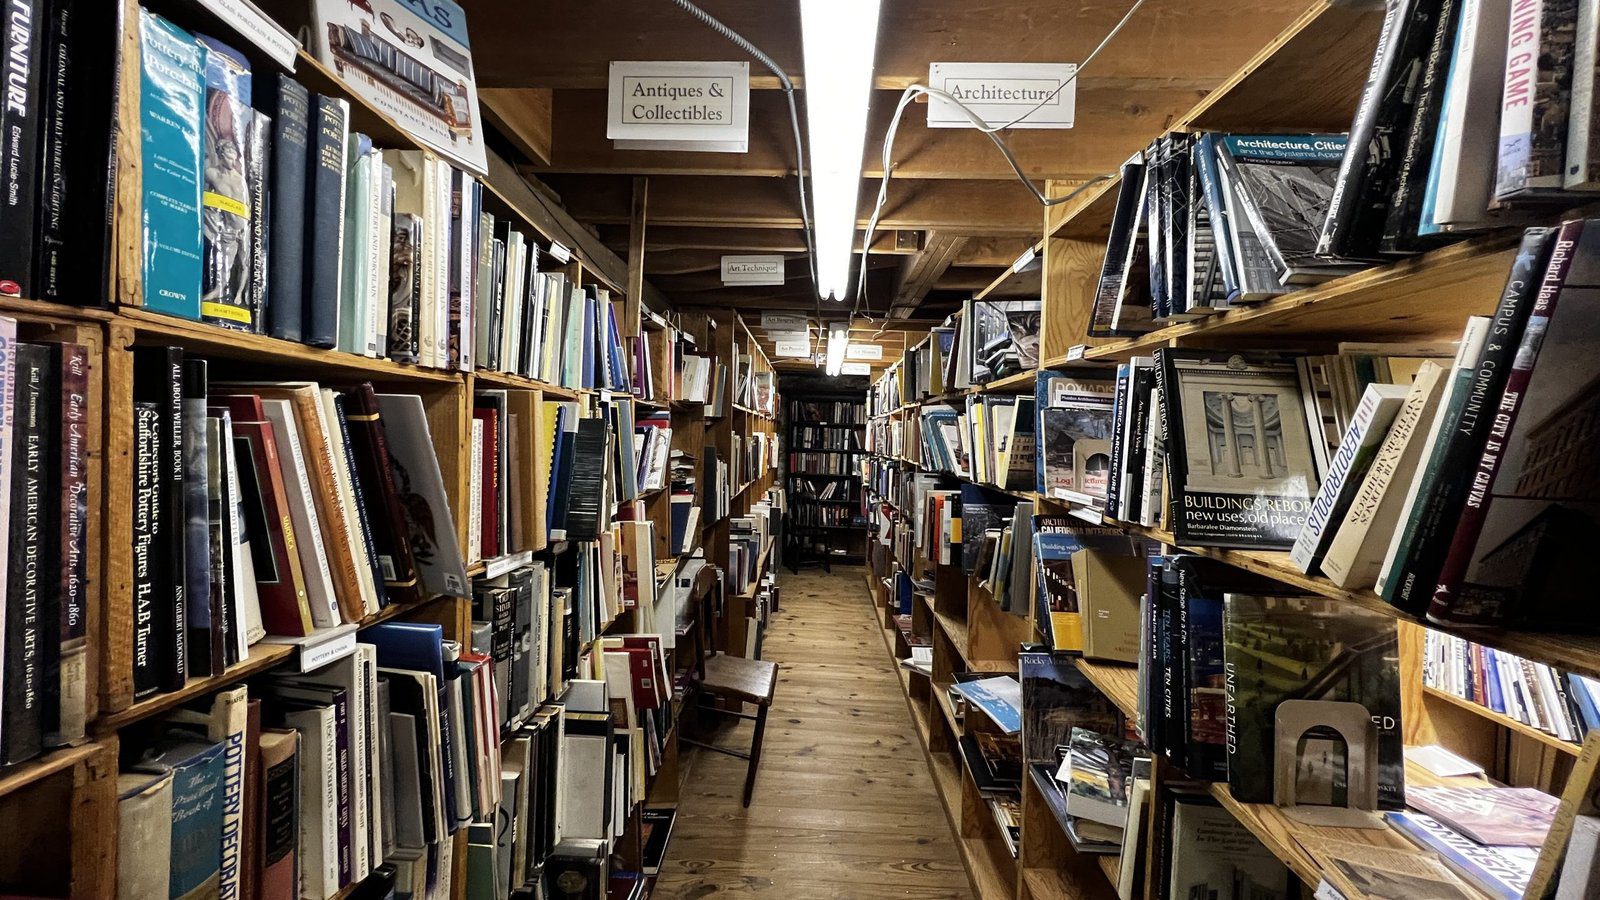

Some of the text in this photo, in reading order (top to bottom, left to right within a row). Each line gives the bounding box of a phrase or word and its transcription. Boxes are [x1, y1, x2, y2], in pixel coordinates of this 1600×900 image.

[8, 0, 31, 117] FURNITURE
[1423, 53, 1439, 88] Boston
[632, 82, 724, 100] Antiques &
[952, 84, 1053, 100] Architecture
[1505, 53, 1533, 112] GAME
[374, 97, 450, 140] CONSTANCE KING
[632, 104, 723, 121] Collectibles
[1236, 139, 1314, 152] Architecture,
[1240, 148, 1316, 158] and the Systems
[9, 125, 22, 207] Edward Lucie-Smith
[51, 183, 60, 229] LIGHTING
[729, 264, 777, 273] Art Technique
[1533, 240, 1574, 311] Richard Haas
[159, 288, 187, 301] CROWN
[1494, 280, 1524, 335] CAMPUS
[1487, 343, 1502, 351] &
[6, 338, 15, 412] ENCYCLOPEDIA
[173, 363, 181, 378] ALL
[1055, 382, 1114, 394] DOXIADIS
[173, 381, 182, 412] ABOUT
[1154, 351, 1168, 441] BUILDINGS REBORN
[1460, 360, 1496, 436] COMMUNITY
[173, 413, 182, 449] WELLER,
[1111, 391, 1126, 492] AMERICAN ARCHITECTURE
[28, 435, 39, 471] EARLY
[151, 421, 160, 481] Collector's
[174, 450, 182, 473] BOOK
[1467, 391, 1519, 509] THE CITY IS MY CANVAS
[68, 356, 83, 627] Krill Early American Decorative Arts, 1620-1860
[1308, 419, 1361, 537] AEROTROPOLIS
[26, 478, 38, 542] AMERICAN
[152, 482, 160, 520] Guide
[1184, 495, 1313, 513] BUILDINGS REBOR
[1186, 509, 1305, 526] new uses, old place
[134, 410, 152, 667] Staffordshire Pottery Figures H.A.B. Turner
[151, 523, 159, 535] to
[282, 515, 295, 551] MAJOLICA
[1187, 522, 1258, 533] Barbaralee Diamonstein
[1042, 543, 1066, 551] Building
[25, 545, 37, 625] DECORATIVE
[24, 628, 36, 662] ARTS,
[176, 630, 184, 675] McDONALD
[1024, 656, 1045, 666] Rocky
[25, 664, 35, 710] 1620-1860
[1164, 667, 1172, 686] TEN
[1225, 662, 1237, 754] UNEARTHED
[223, 732, 243, 813] POTTERY
